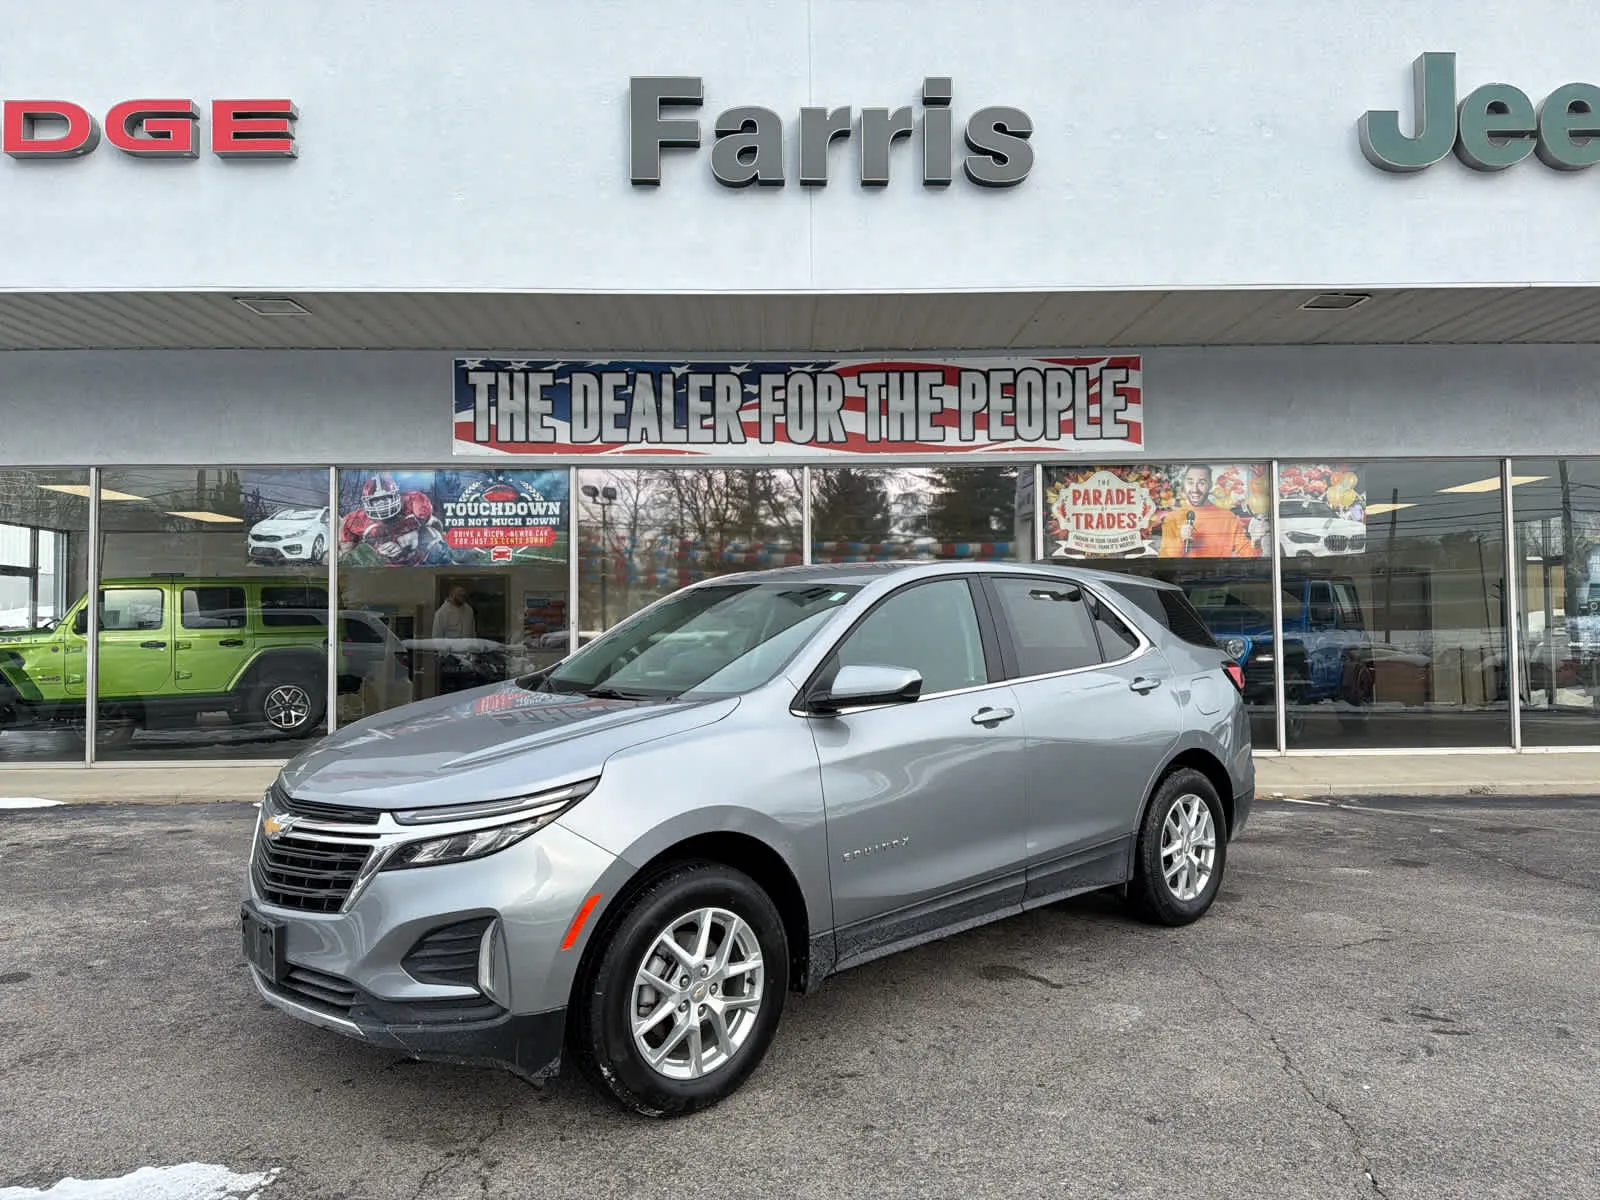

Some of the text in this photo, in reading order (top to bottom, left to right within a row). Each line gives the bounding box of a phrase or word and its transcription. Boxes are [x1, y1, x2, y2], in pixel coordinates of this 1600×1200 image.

[629, 75, 1035, 187] Farris
[467, 367, 1129, 444] THE DEALER FOR THE PEOPLE
[1072, 488, 1136, 506] PARADE
[443, 501, 561, 516] TOUCHDOWN
[445, 517, 560, 526] FOR NOT MUCH DOWN!
[1072, 512, 1137, 530] TRADES
[454, 530, 474, 538] DRIVE
[535, 529, 548, 537] CAR
[455, 537, 468, 545] FOR
[472, 537, 488, 545] JUST
